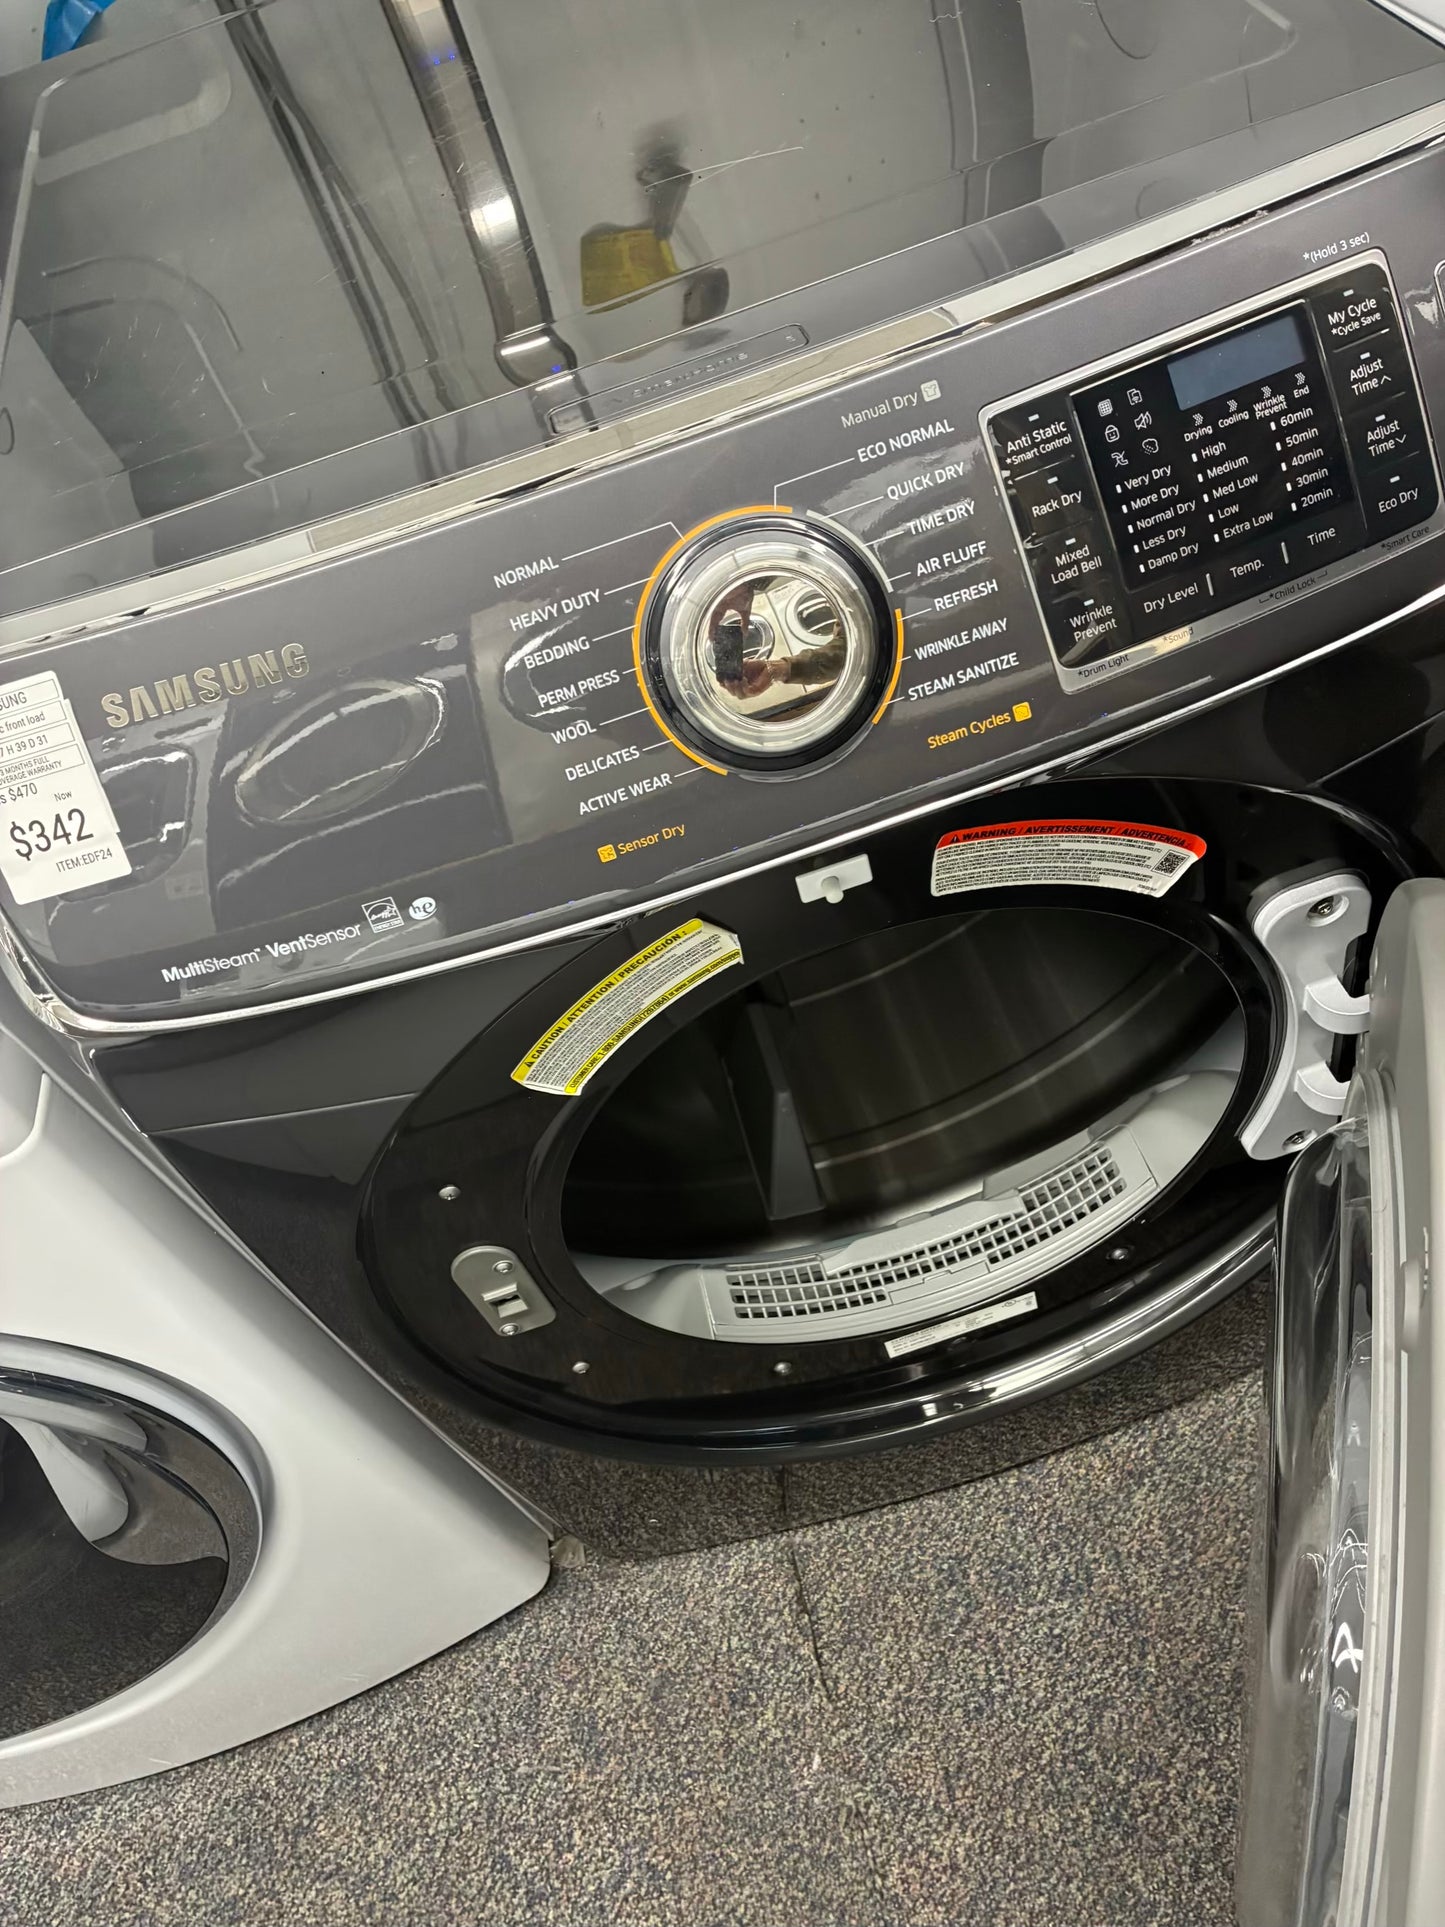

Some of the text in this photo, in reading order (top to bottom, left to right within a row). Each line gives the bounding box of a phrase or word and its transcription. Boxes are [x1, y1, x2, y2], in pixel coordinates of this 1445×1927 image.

[1340, 240, 1348, 250] 3
[1350, 232, 1370, 248] sec)
[1328, 298, 1378, 326] My Cycle
[1360, 311, 1382, 326] Save
[1350, 358, 1384, 382] Adjust
[1293, 385, 1310, 399] End
[1352, 377, 1380, 396] Time
[841, 390, 919, 429] Manual Dry
[1253, 394, 1285, 412] Wrinkle
[1256, 402, 1288, 420] Prevent
[1218, 410, 1250, 428] Cooling
[1280, 406, 1314, 428] 60min
[856, 418, 954, 463] ECO NORMAL
[1006, 420, 1068, 454] Anti Static
[1184, 424, 1213, 442] Drying
[1286, 427, 1318, 448] 50min
[1366, 420, 1400, 444] Adjust
[1039, 434, 1073, 457] Control
[1200, 441, 1227, 460] High
[1292, 447, 1324, 467] 40min
[1368, 438, 1396, 458] Time
[1124, 464, 1172, 492] Very Dry
[1206, 454, 1249, 480] Medium
[1296, 466, 1328, 487] 30min
[886, 462, 965, 502] QUICK DRY
[1212, 473, 1259, 500] Med Low
[1032, 490, 1084, 518] Rack Dry
[1130, 484, 1180, 511] More Dry
[1301, 486, 1334, 508] 20min
[1378, 487, 1419, 514] Eco Dry
[906, 500, 976, 536] TIME DRY
[1136, 500, 1196, 531] Normal Dry
[1218, 503, 1240, 520] Low
[1142, 525, 1186, 551] Less Dry
[1223, 512, 1274, 539] Extra Low
[1307, 526, 1336, 546] Time
[1412, 524, 1430, 540] Care
[916, 541, 988, 576] AIR FLUFF
[1055, 544, 1090, 568] Mixed
[1148, 542, 1200, 572] Damp Dry
[1230, 558, 1265, 578] Temp.
[494, 556, 560, 588] NORMAL
[1051, 556, 1103, 584] Load Bell
[934, 579, 999, 612] REFRESH
[1297, 577, 1316, 592] Lock
[510, 588, 602, 632] HEAVY DUTY
[1143, 582, 1199, 614] Dry Level
[1070, 603, 1113, 629] Wrinkle
[914, 618, 1009, 660] WRINKLE AWAY
[1074, 618, 1118, 642] Prevent
[524, 636, 590, 670] BEDDING
[1107, 654, 1130, 670] Light
[101, 643, 310, 728] SAMSUNG
[538, 670, 620, 708] PERM PRESS
[908, 652, 1020, 702] STEAM SANITIZE
[5, 718, 26, 731] front
[26, 711, 46, 726] load
[552, 722, 597, 744] WOOL
[928, 710, 1012, 750] Steam Cycles
[6, 744, 15, 755] H
[15, 740, 28, 752] 39
[28, 736, 36, 748] D
[38, 734, 49, 747] 31
[4, 762, 34, 775] MONTHS
[33, 756, 50, 766] FULL
[27, 760, 62, 777] WARRANTY
[565, 745, 640, 782] DELICATES
[8, 782, 38, 802] $470
[54, 790, 73, 802] Now
[579, 772, 672, 815] ACTIVE WEAR
[10, 808, 94, 861] $342
[618, 824, 686, 855] Sensor Dry
[962, 826, 1017, 842] WARNING
[1025, 824, 1116, 836] AVERTISSEMENT
[56, 848, 113, 873] ITEM:EDF24
[265, 922, 362, 959] VentSensor
[532, 1026, 564, 1060] CAUTION
[567, 980, 614, 1022] ATTENTION
[618, 932, 681, 978] PRECAUCIÓN
